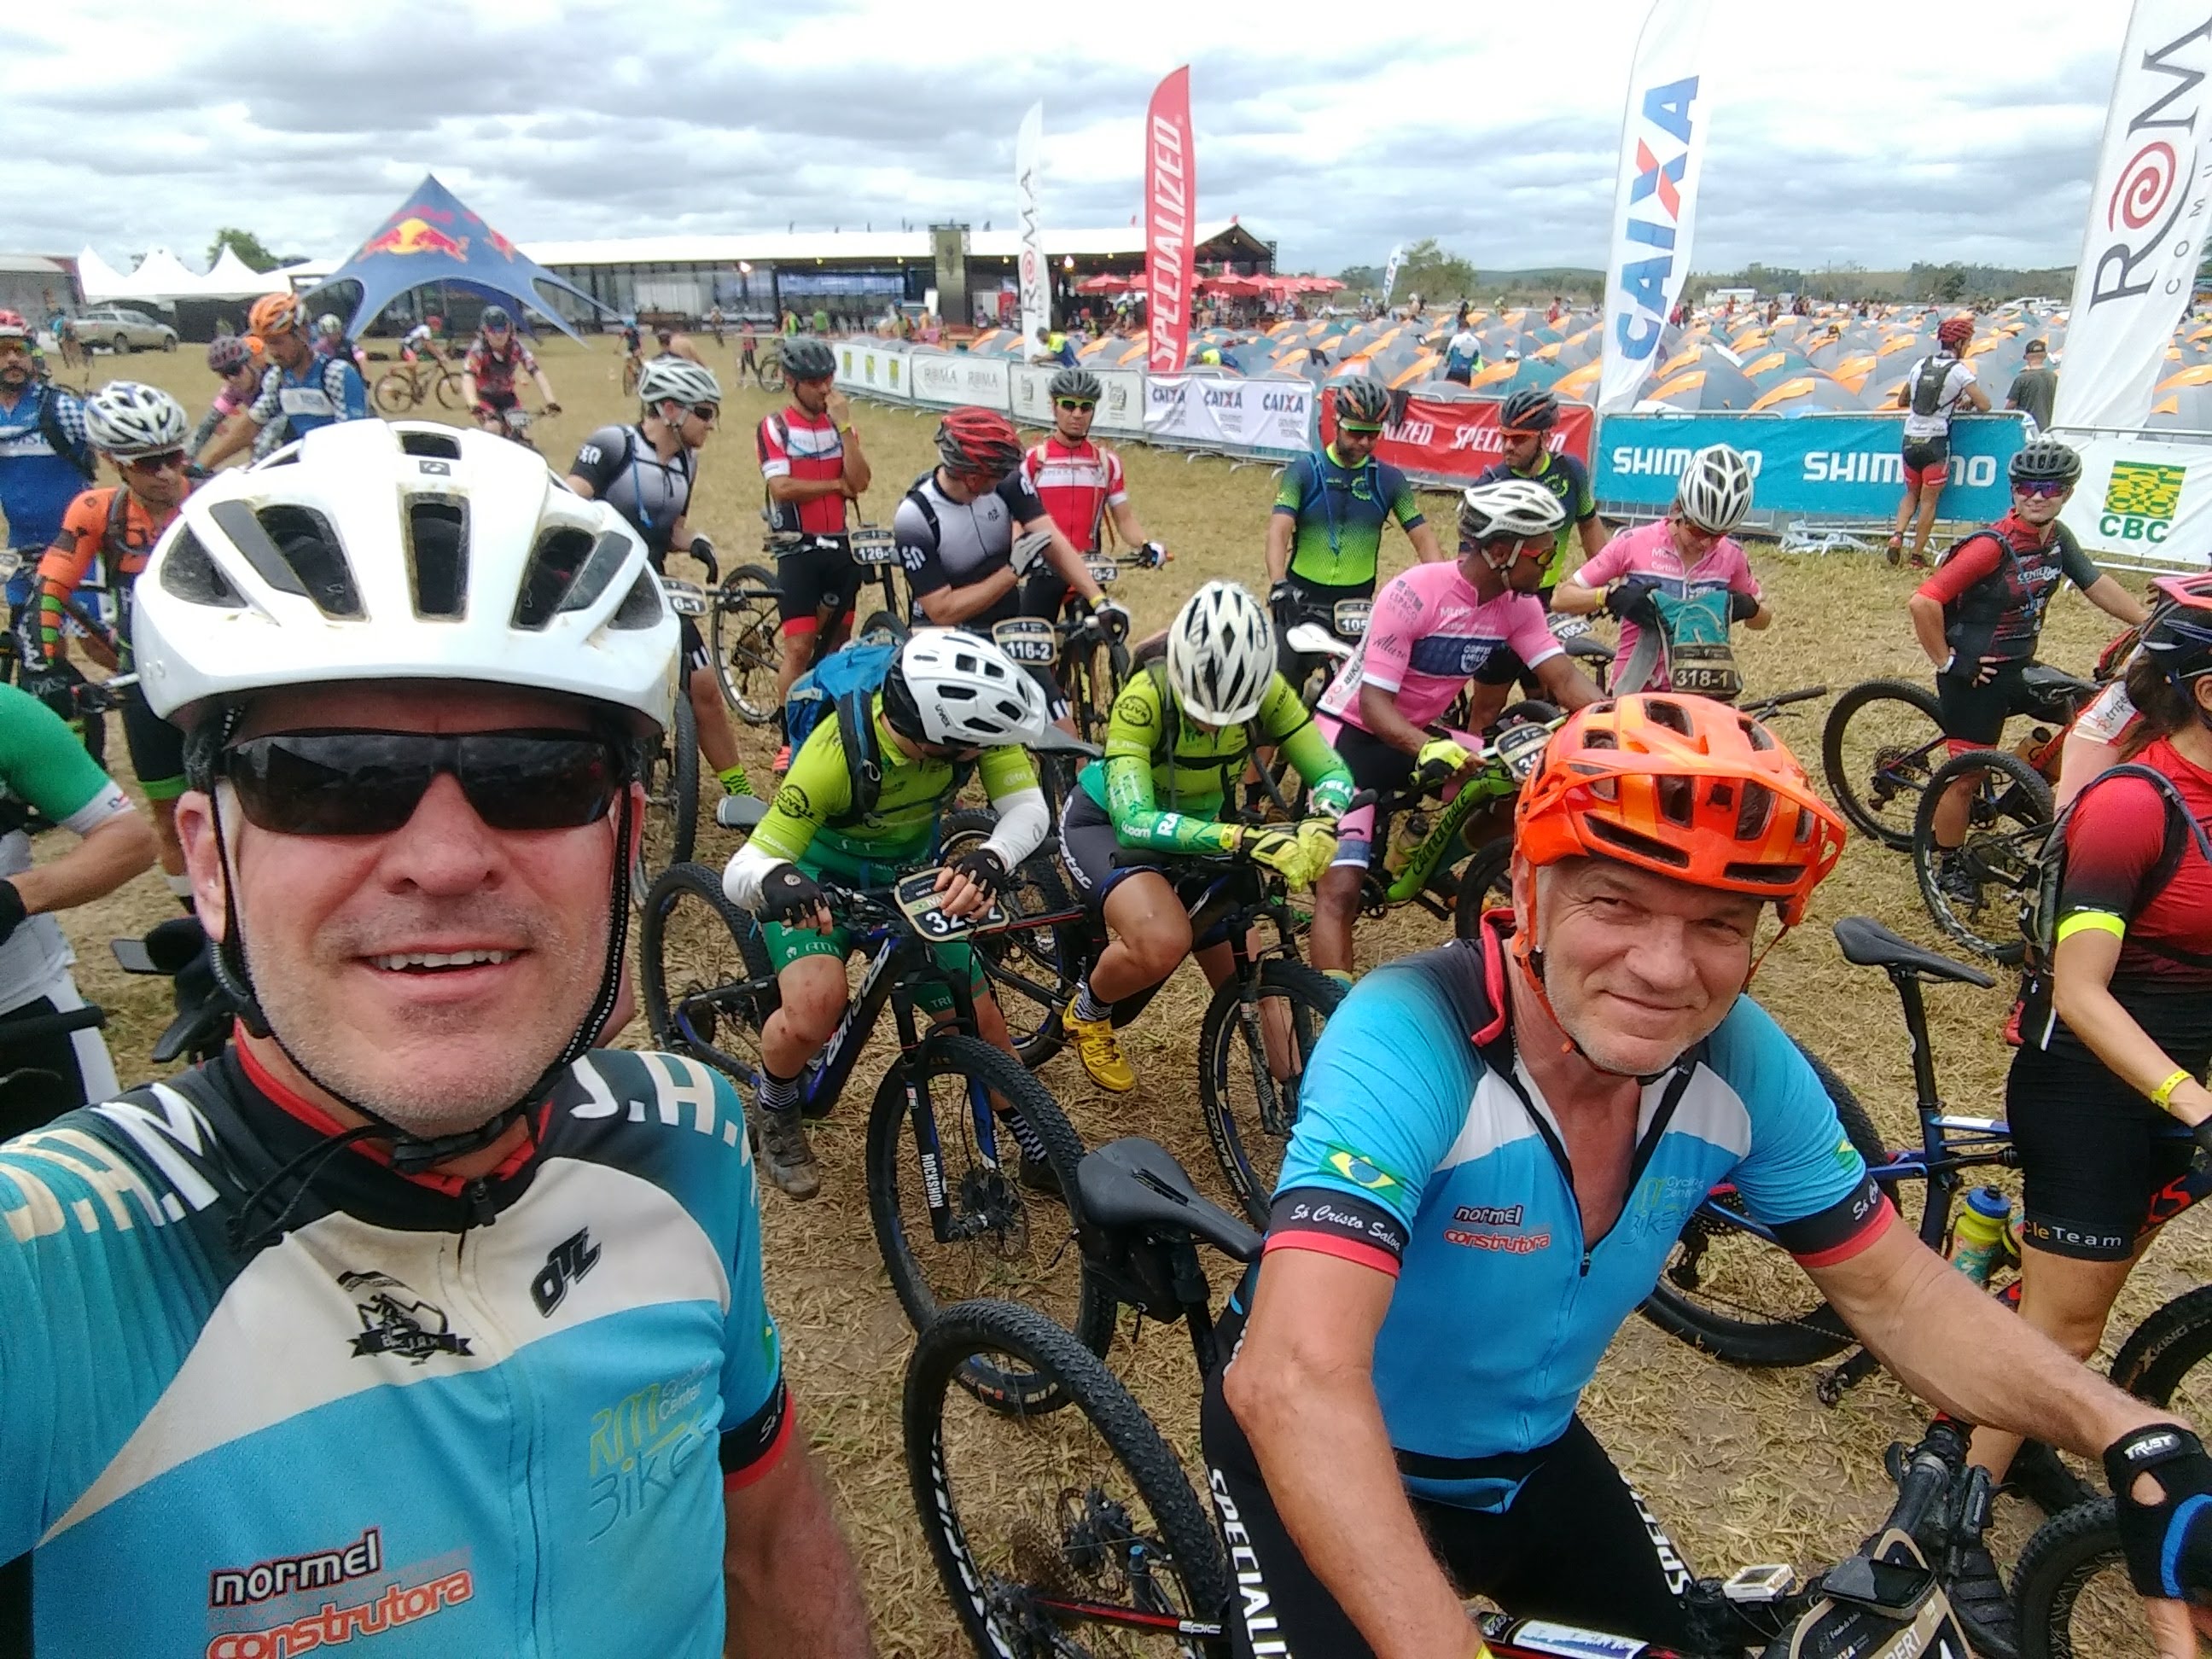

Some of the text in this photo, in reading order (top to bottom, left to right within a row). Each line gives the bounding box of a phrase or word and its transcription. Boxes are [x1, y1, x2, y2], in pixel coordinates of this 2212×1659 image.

[1617, 75, 1699, 361] CAIXA
[1152, 114, 1186, 372] SPECIALIZED
[1152, 387, 1185, 405] CAIXA
[1203, 389, 1242, 410] CAIXA
[1262, 393, 1304, 414] CAIXA
[1803, 451, 1997, 487] SHIMNO
[2098, 514, 2169, 544] CBC
[1007, 642, 1051, 660] 116-2
[1675, 669, 1728, 688] 318-1
[921, 1153, 944, 1208] ROCKSHOX
[1312, 1204, 1364, 1230] Cristo
[1365, 1220, 1402, 1252] Salva
[1453, 1204, 1524, 1227] normel
[1443, 1228, 1551, 1255] construtora
[2123, 1434, 2175, 1460] TRUST
[211, 1528, 381, 1605] normel
[206, 1569, 474, 1659] construtora
